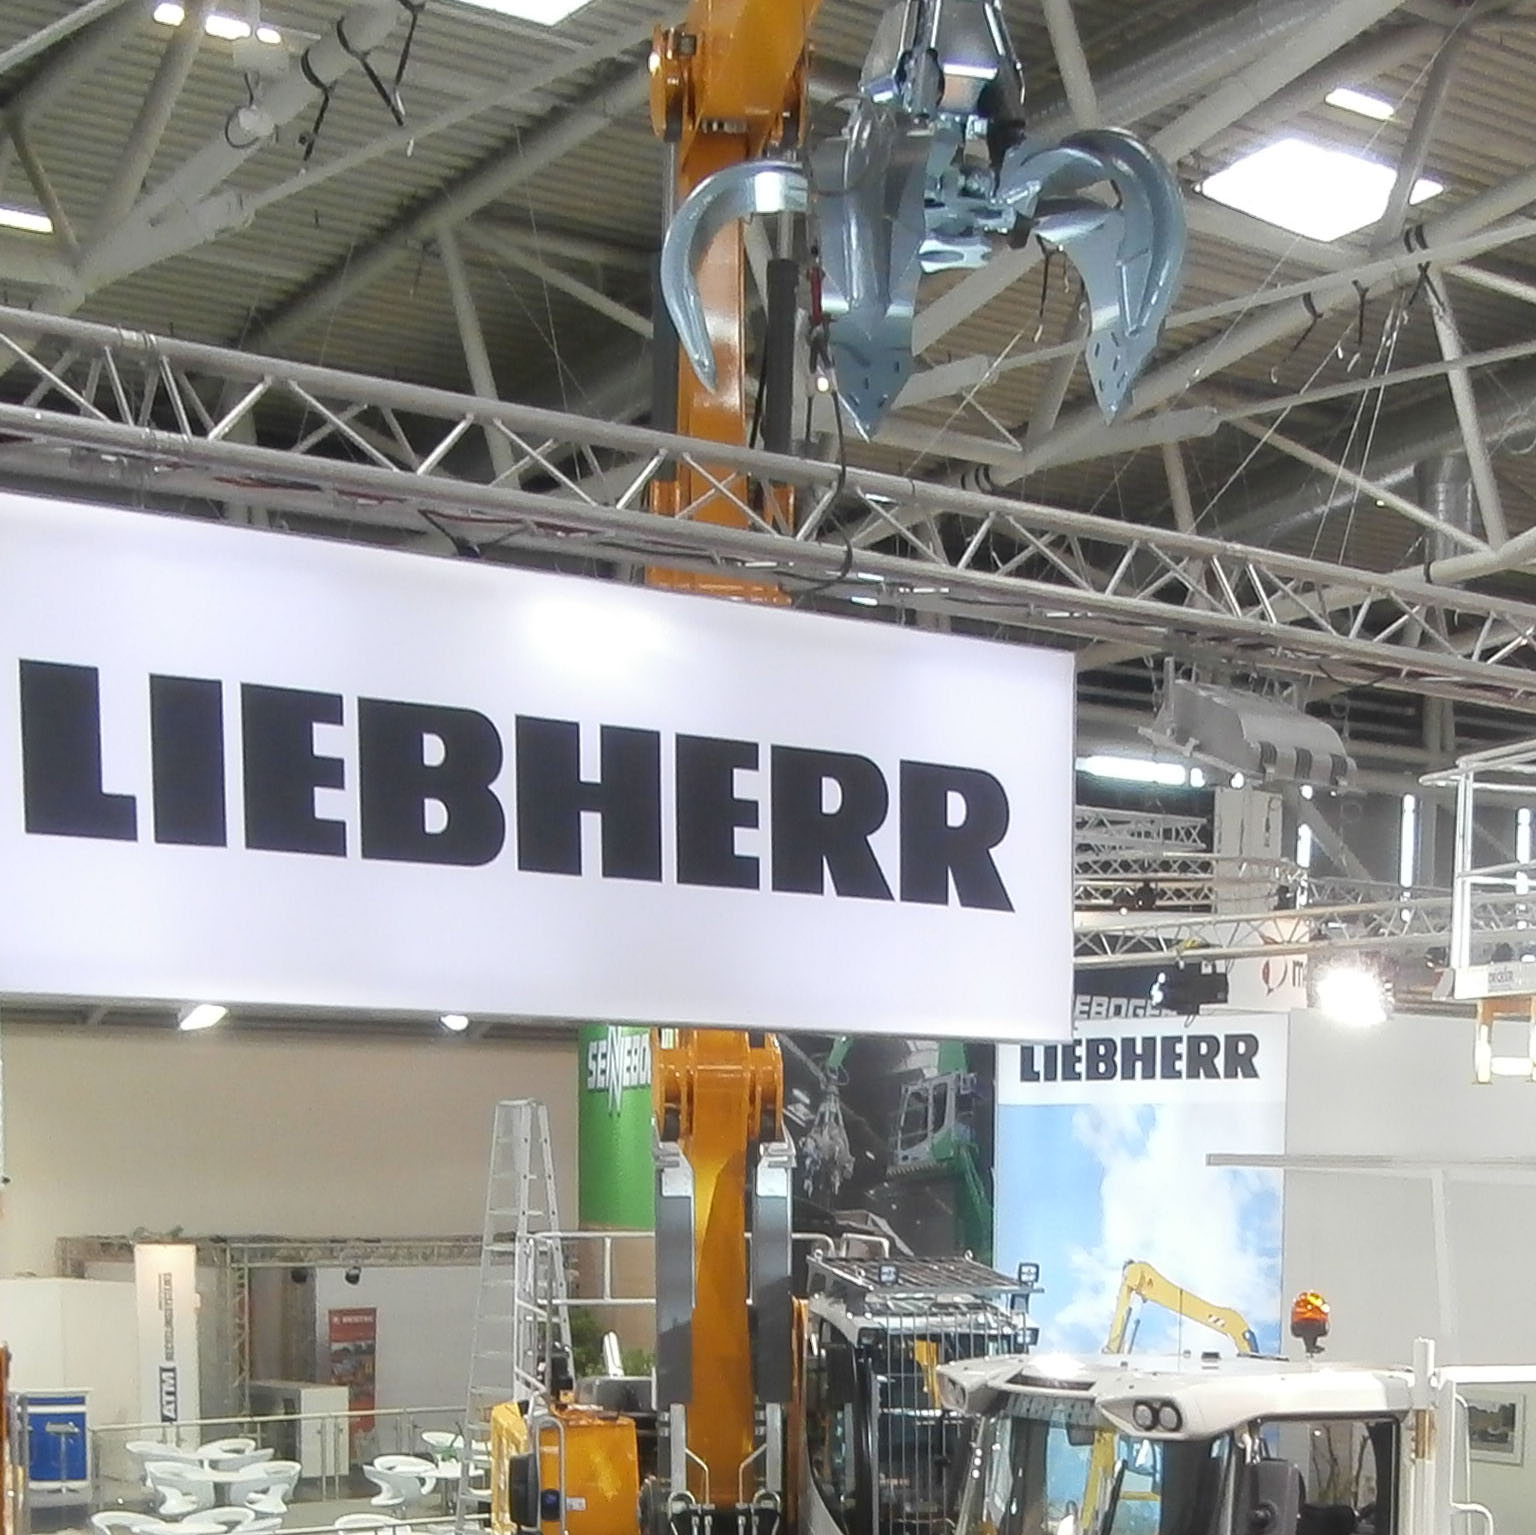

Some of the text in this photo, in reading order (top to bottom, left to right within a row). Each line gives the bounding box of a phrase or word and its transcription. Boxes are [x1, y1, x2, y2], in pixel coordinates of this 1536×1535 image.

[18, 656, 1016, 914] LIEBHERR
[1019, 1033, 1261, 1083] LIEBHERR
[160, 1367, 176, 1420] ATM
